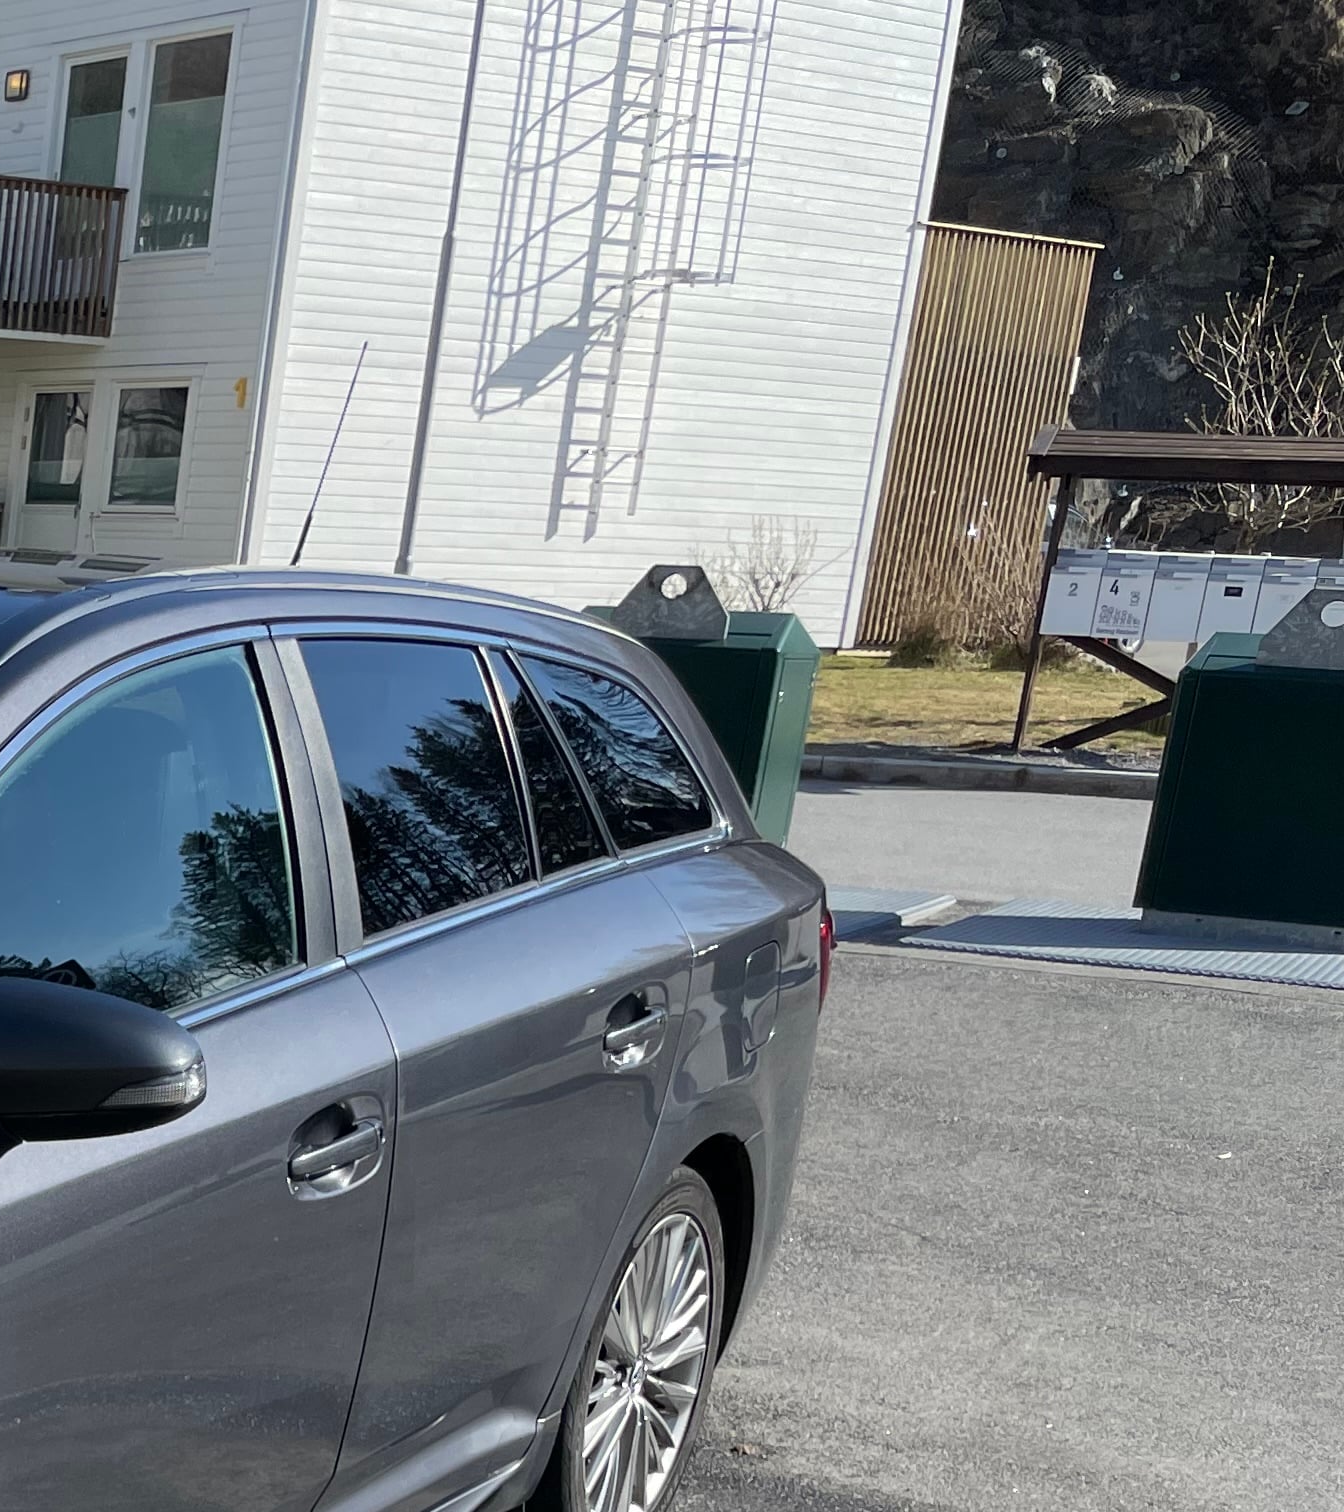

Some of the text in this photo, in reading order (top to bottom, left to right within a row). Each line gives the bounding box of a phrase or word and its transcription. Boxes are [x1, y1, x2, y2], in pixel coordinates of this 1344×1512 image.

[233, 376, 247, 409] 1
[1068, 582, 1079, 597] 2
[1109, 579, 1119, 596] 4
